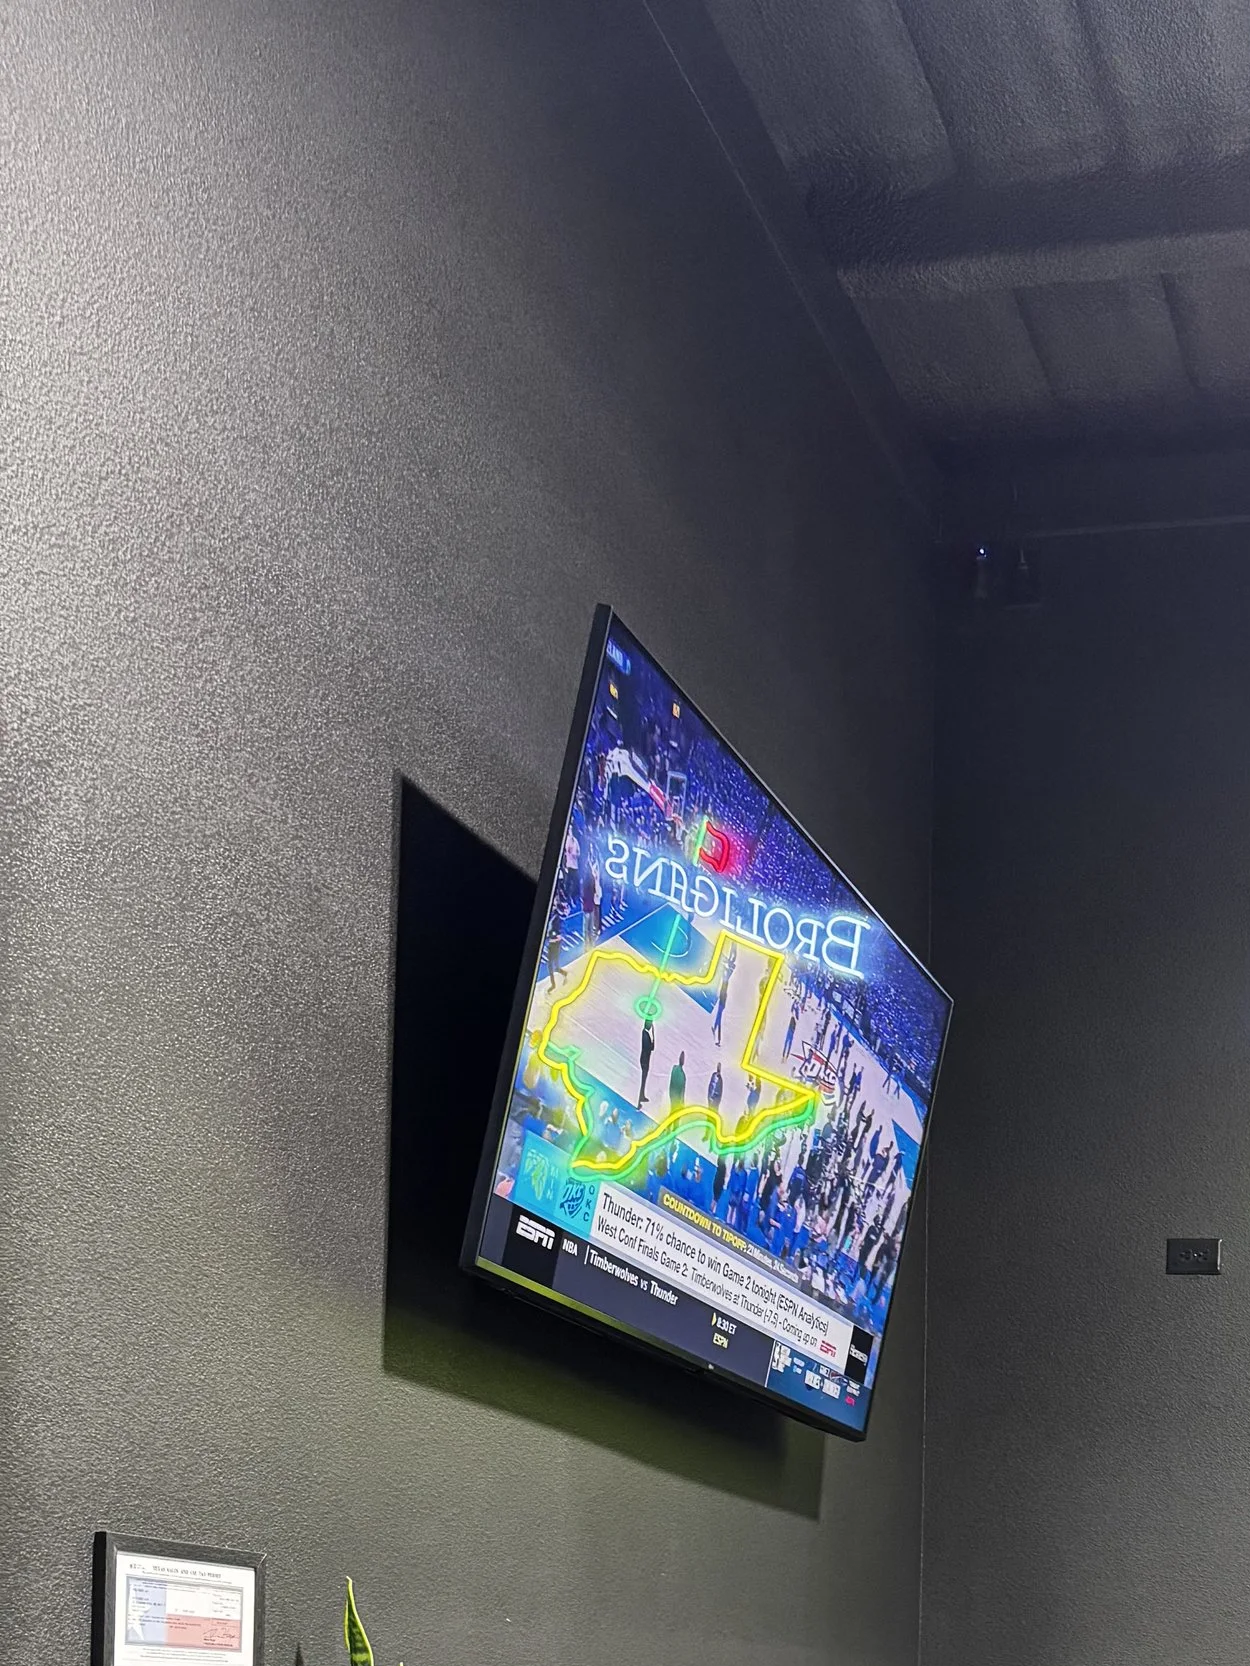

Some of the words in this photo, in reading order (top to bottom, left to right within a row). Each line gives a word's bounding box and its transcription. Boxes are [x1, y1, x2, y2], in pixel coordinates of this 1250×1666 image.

[515, 1213, 554, 1250] ESPN
[562, 1239, 577, 1255] NBA
[589, 1250, 638, 1287] Timberwolves
[639, 1279, 647, 1291] vs
[648, 1281, 677, 1306] Thunder
[601, 1193, 642, 1228] Thunder:
[644, 1218, 663, 1240] 71%
[665, 1230, 695, 1258] chance
[697, 1248, 706, 1264] to
[707, 1254, 720, 1273] win
[722, 1262, 743, 1286] Game
[745, 1276, 751, 1289] 2
[750, 1279, 776, 1306] tonight
[776, 1294, 797, 1316] (ESPN
[797, 1306, 827, 1335] Analytics)
[662, 1192, 710, 1230] COUNTDOWN
[712, 1223, 721, 1237] TO
[597, 1216, 616, 1238] West
[618, 1228, 635, 1248] Conf
[637, 1239, 658, 1261] Finals
[660, 1251, 680, 1272] Game
[681, 1263, 688, 1277] 2:
[690, 1268, 732, 1301] Timberwolves
[732, 1292, 739, 1304] at
[739, 1295, 762, 1317] Thunder
[782, 1319, 801, 1340] Coming
[802, 1332, 809, 1344] up
[810, 1336, 817, 1346] on
